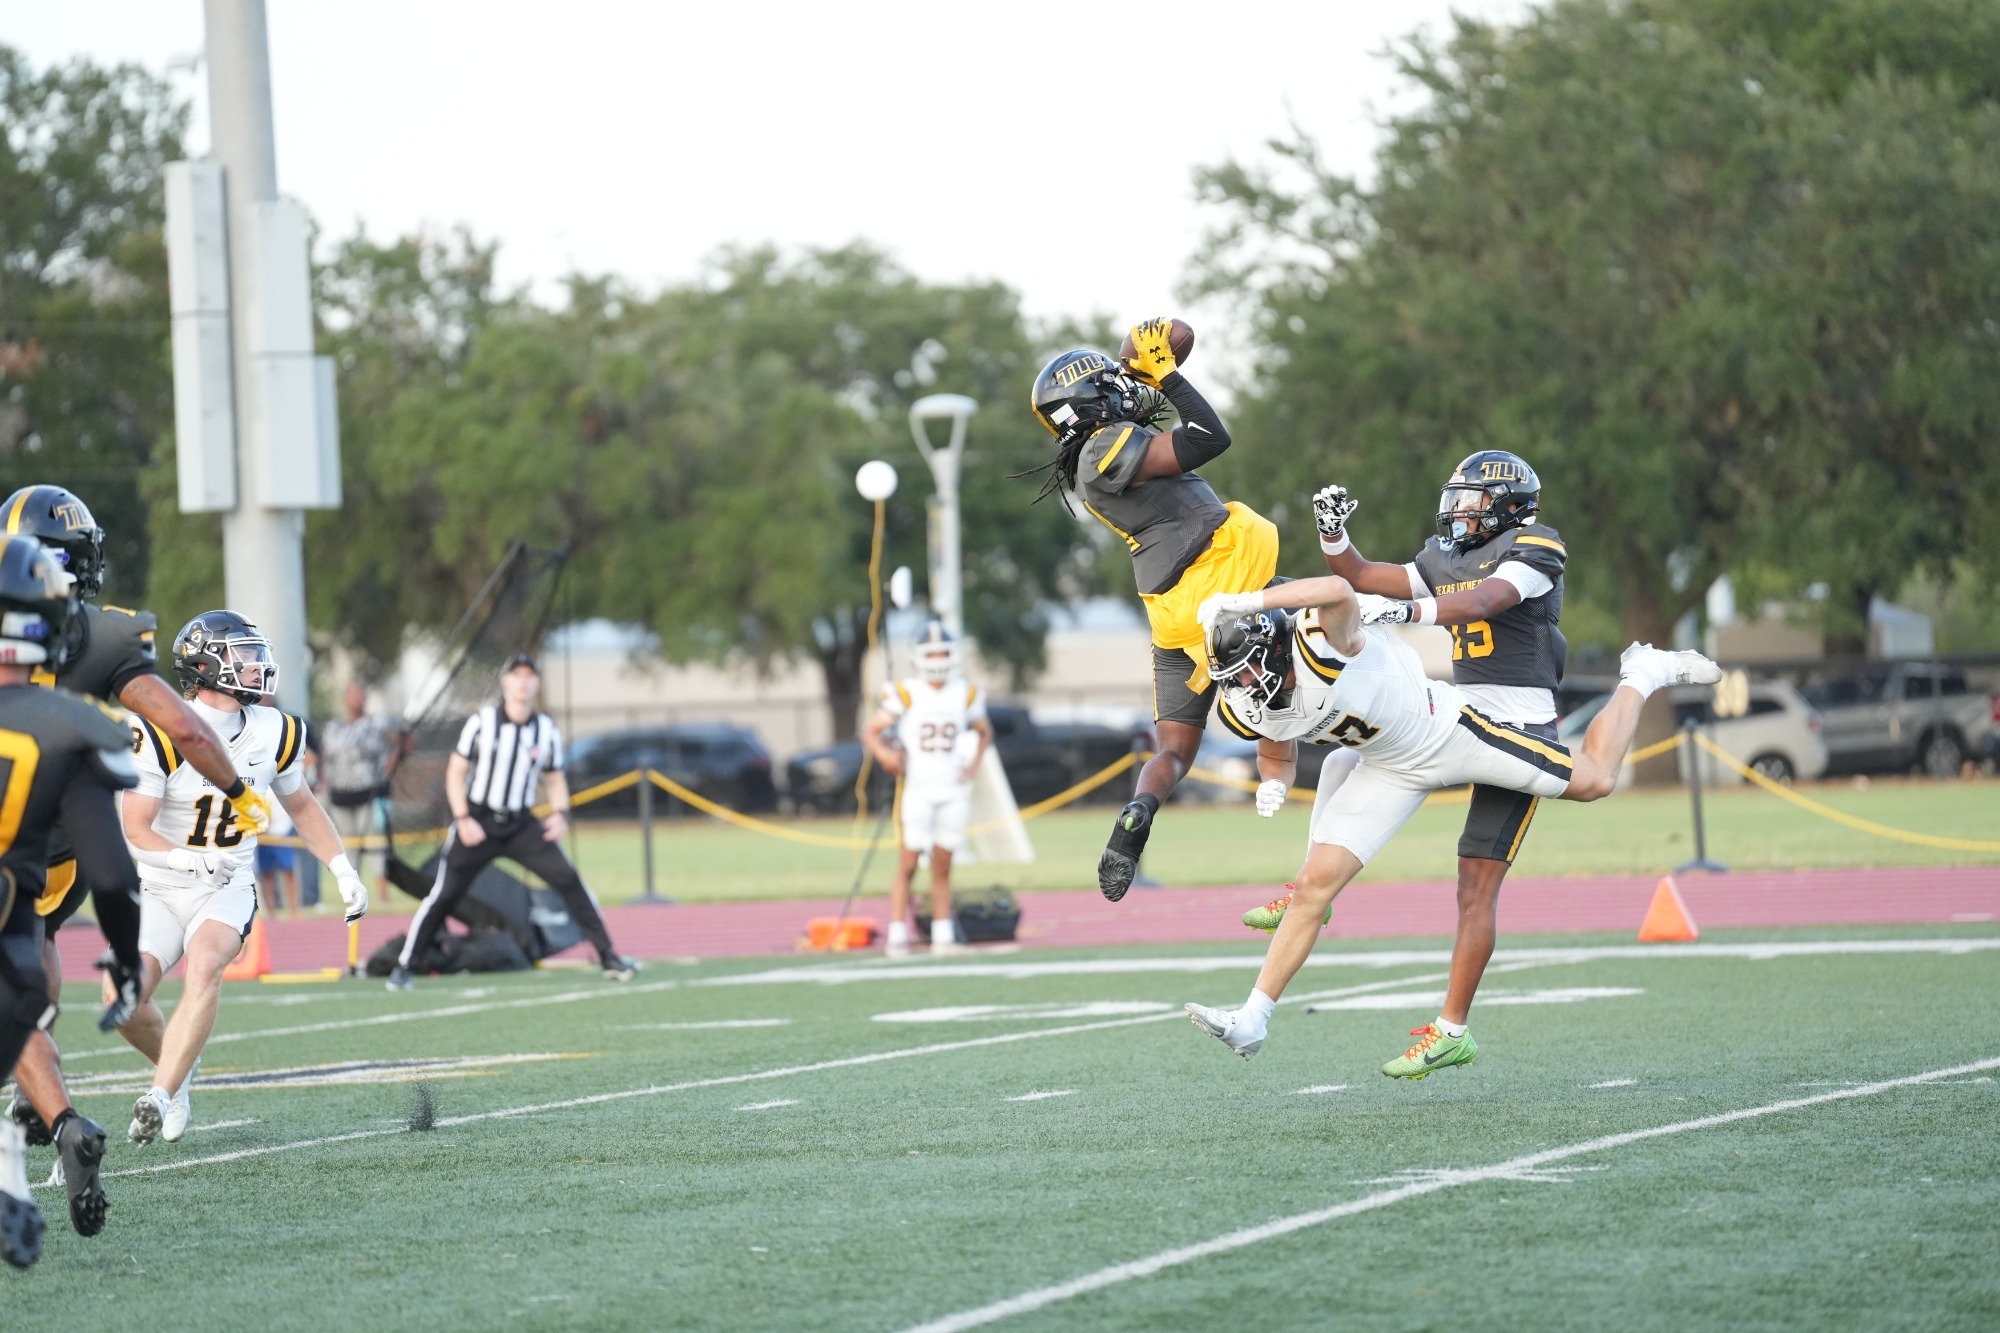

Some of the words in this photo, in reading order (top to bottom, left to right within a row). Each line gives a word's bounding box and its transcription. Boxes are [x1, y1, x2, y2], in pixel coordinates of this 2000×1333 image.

[1056, 354, 1106, 388] TLU
[1481, 461, 1529, 485] TLU
[56, 503, 92, 532] TL
[1435, 583, 1455, 596] TEXAS
[919, 722, 958, 753] 29
[186, 793, 245, 849] 18
